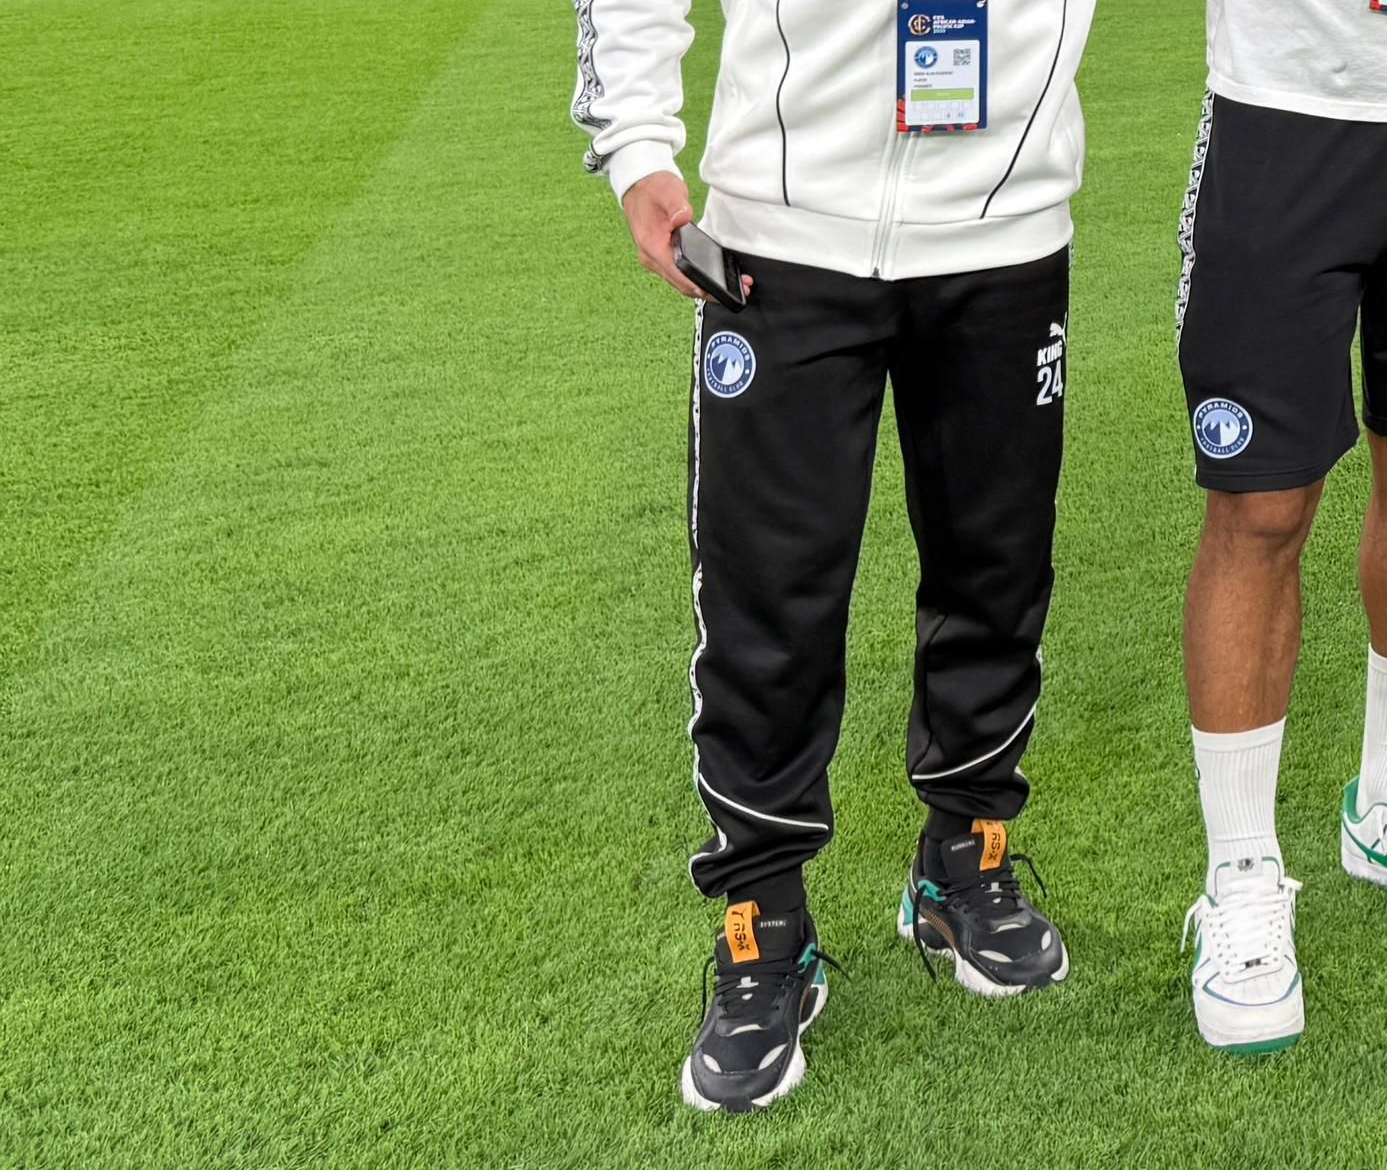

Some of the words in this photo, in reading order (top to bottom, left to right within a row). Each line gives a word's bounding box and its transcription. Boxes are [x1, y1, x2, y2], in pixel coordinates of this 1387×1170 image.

[710, 336, 750, 360] PYRAMIDS
[1036, 340, 1064, 368] KING
[1036, 360, 1064, 406] 24
[1198, 402, 1243, 420] PYRAMIDS
